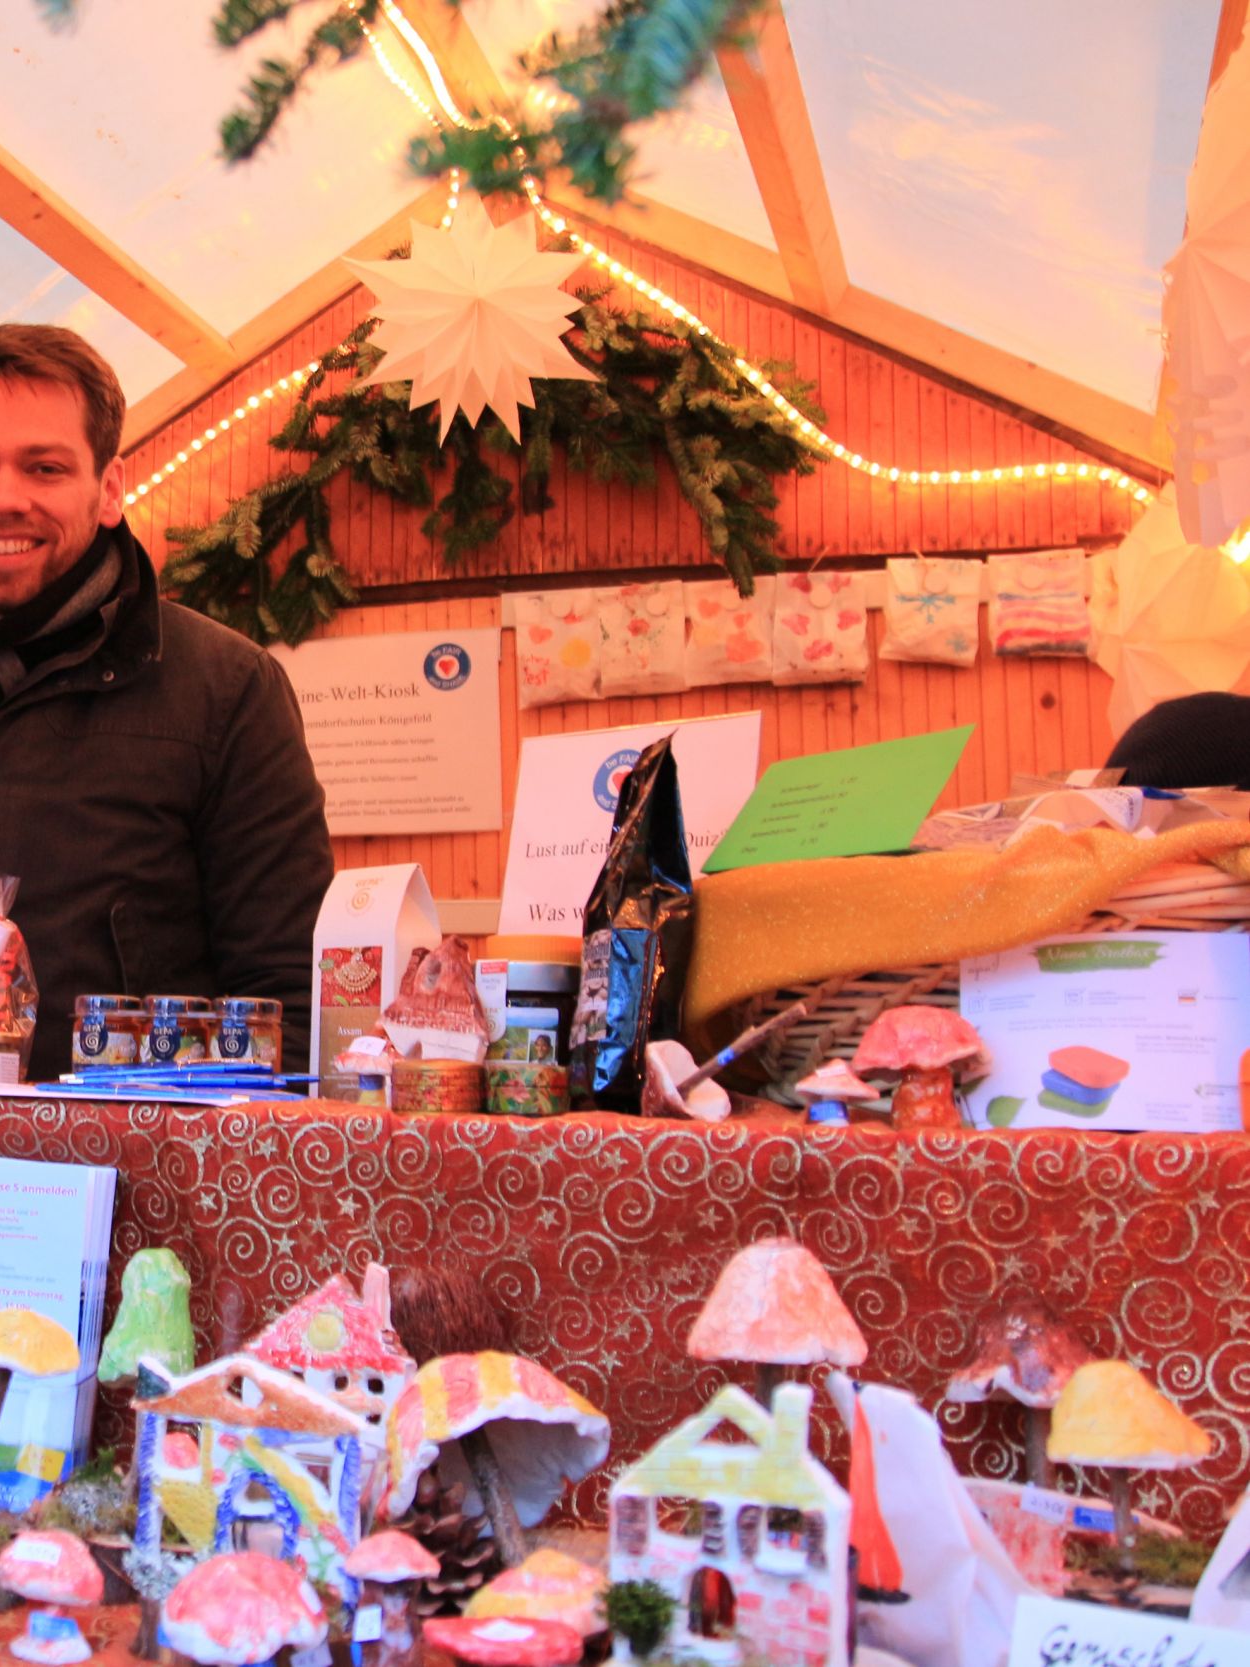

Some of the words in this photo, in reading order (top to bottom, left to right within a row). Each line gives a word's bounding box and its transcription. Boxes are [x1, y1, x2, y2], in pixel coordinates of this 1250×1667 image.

[379, 712, 432, 727] Königsfeld
[525, 841, 557, 859] Lust
[561, 838, 588, 857] auf
[528, 904, 566, 922] Was
[13, 1183, 20, 1192] 5
[21, 1184, 78, 1197] anmelden!
[12, 1287, 26, 1297] am
